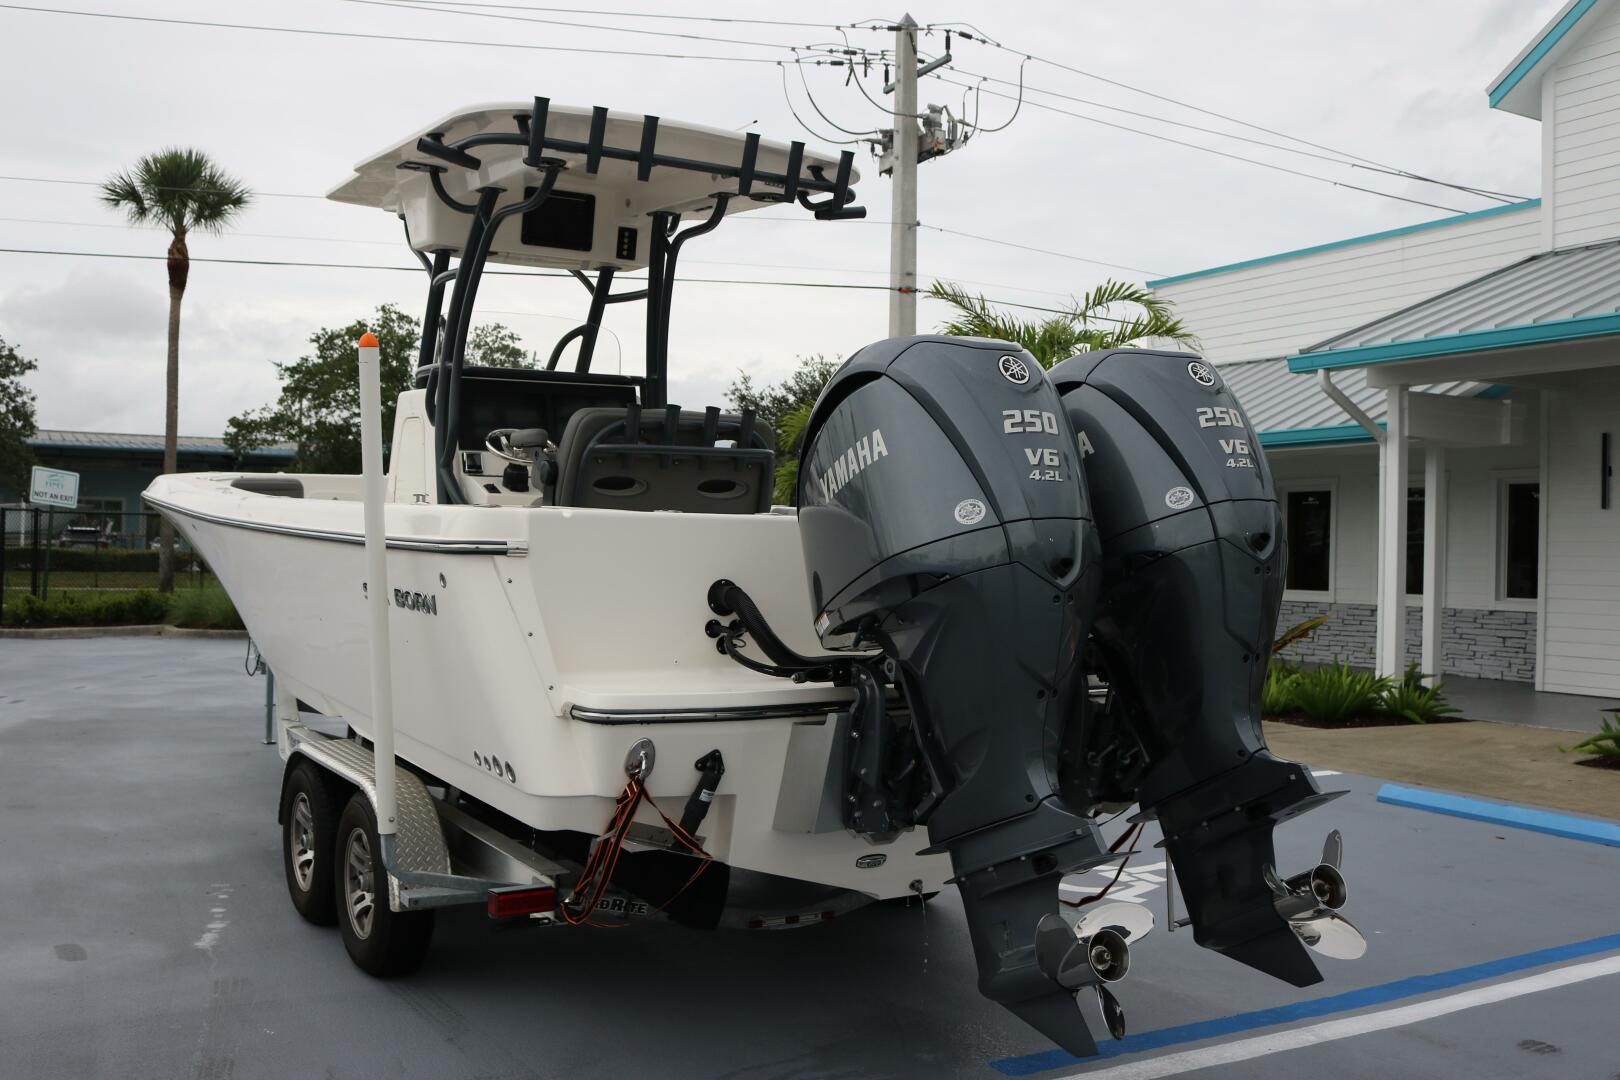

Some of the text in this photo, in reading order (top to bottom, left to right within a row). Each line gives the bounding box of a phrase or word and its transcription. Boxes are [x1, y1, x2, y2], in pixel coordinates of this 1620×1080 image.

[1002, 409, 1059, 435] 250
[1196, 406, 1245, 429] 250
[1218, 438, 1250, 455] V6
[819, 428, 889, 504] YAMAHA
[1023, 447, 1060, 467] V6
[1225, 457, 1256, 468] 4.2L
[1028, 469, 1065, 482] 4.2L
[49, 492, 58, 500] AN
[60, 494, 73, 502] EXIT
[394, 588, 437, 616] BORN
